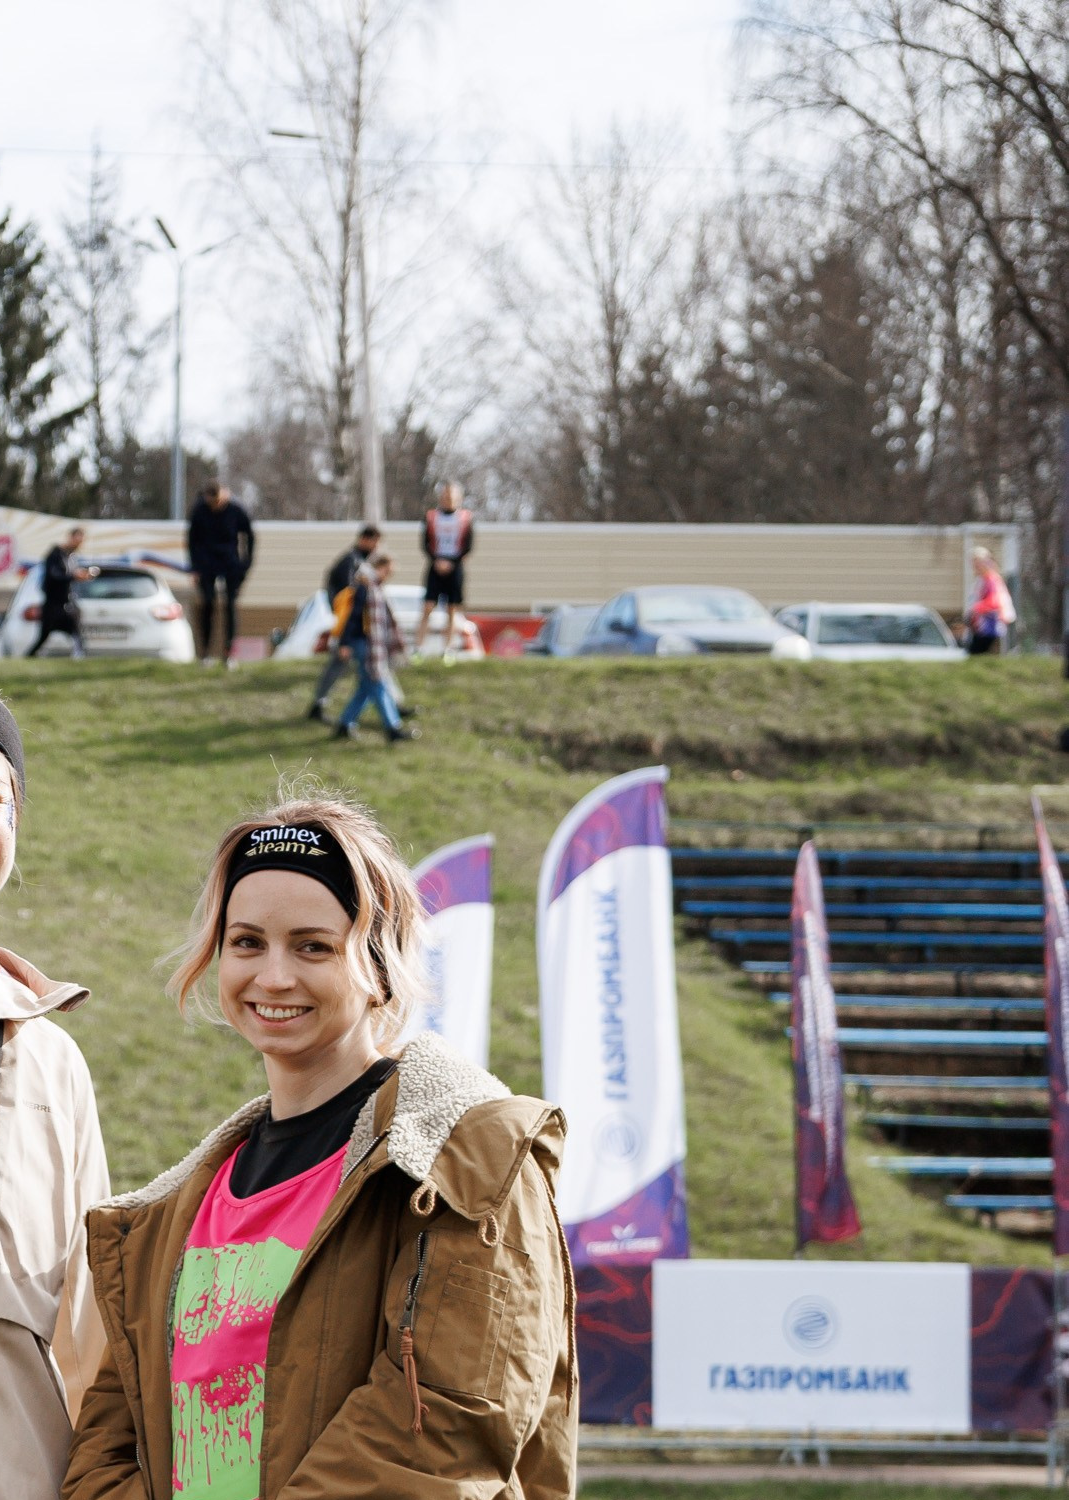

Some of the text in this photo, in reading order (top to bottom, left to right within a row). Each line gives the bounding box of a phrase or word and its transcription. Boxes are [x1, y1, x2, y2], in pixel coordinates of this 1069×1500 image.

[251, 825, 322, 846] Sminex
[258, 841, 306, 854] team
[593, 887, 629, 1100] ГАЗПРОМБАНК
[709, 1364, 910, 1391] ГАЗПРОМБАНК
